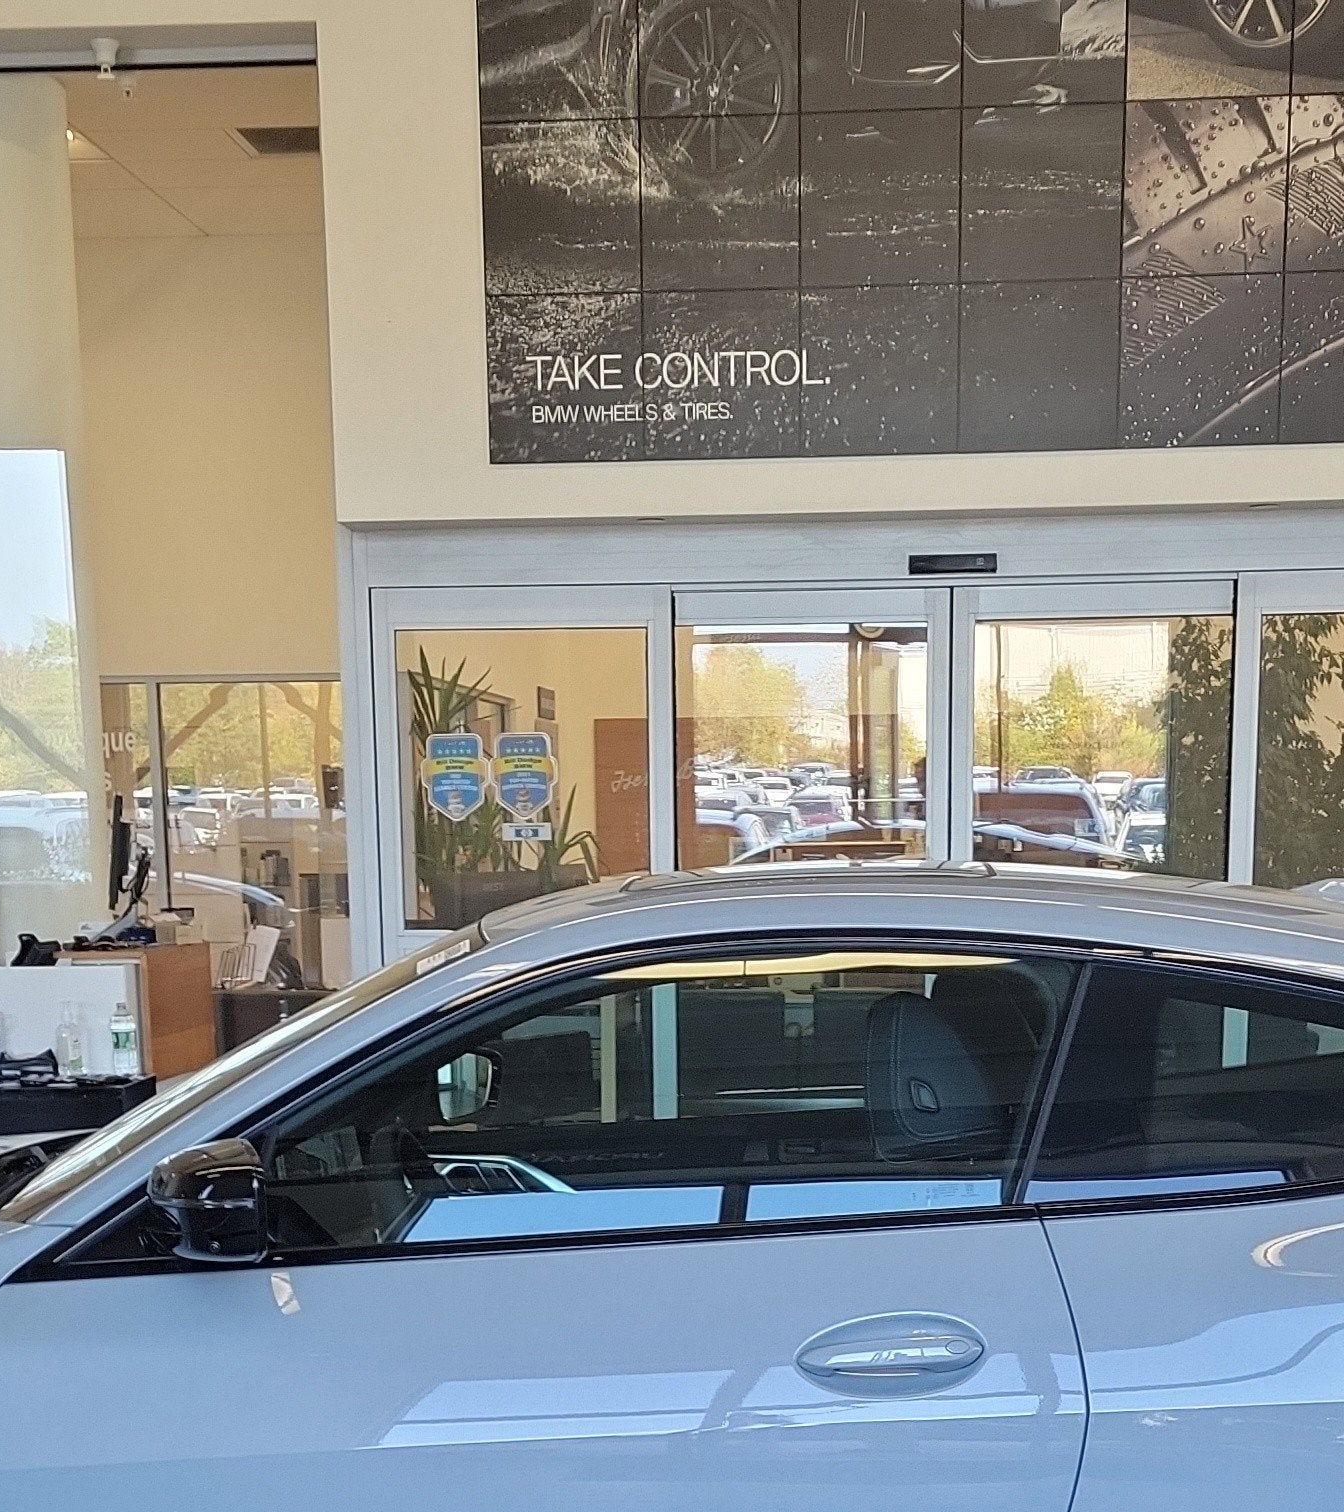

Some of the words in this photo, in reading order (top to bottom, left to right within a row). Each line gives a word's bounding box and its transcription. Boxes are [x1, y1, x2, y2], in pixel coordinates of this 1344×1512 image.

[526, 352, 623, 391] TAKE
[635, 348, 832, 389] CONTROL.
[531, 404, 580, 424] BMW
[584, 402, 659, 423] WHEELS
[662, 402, 676, 421] &
[682, 401, 734, 421] TIRES.
